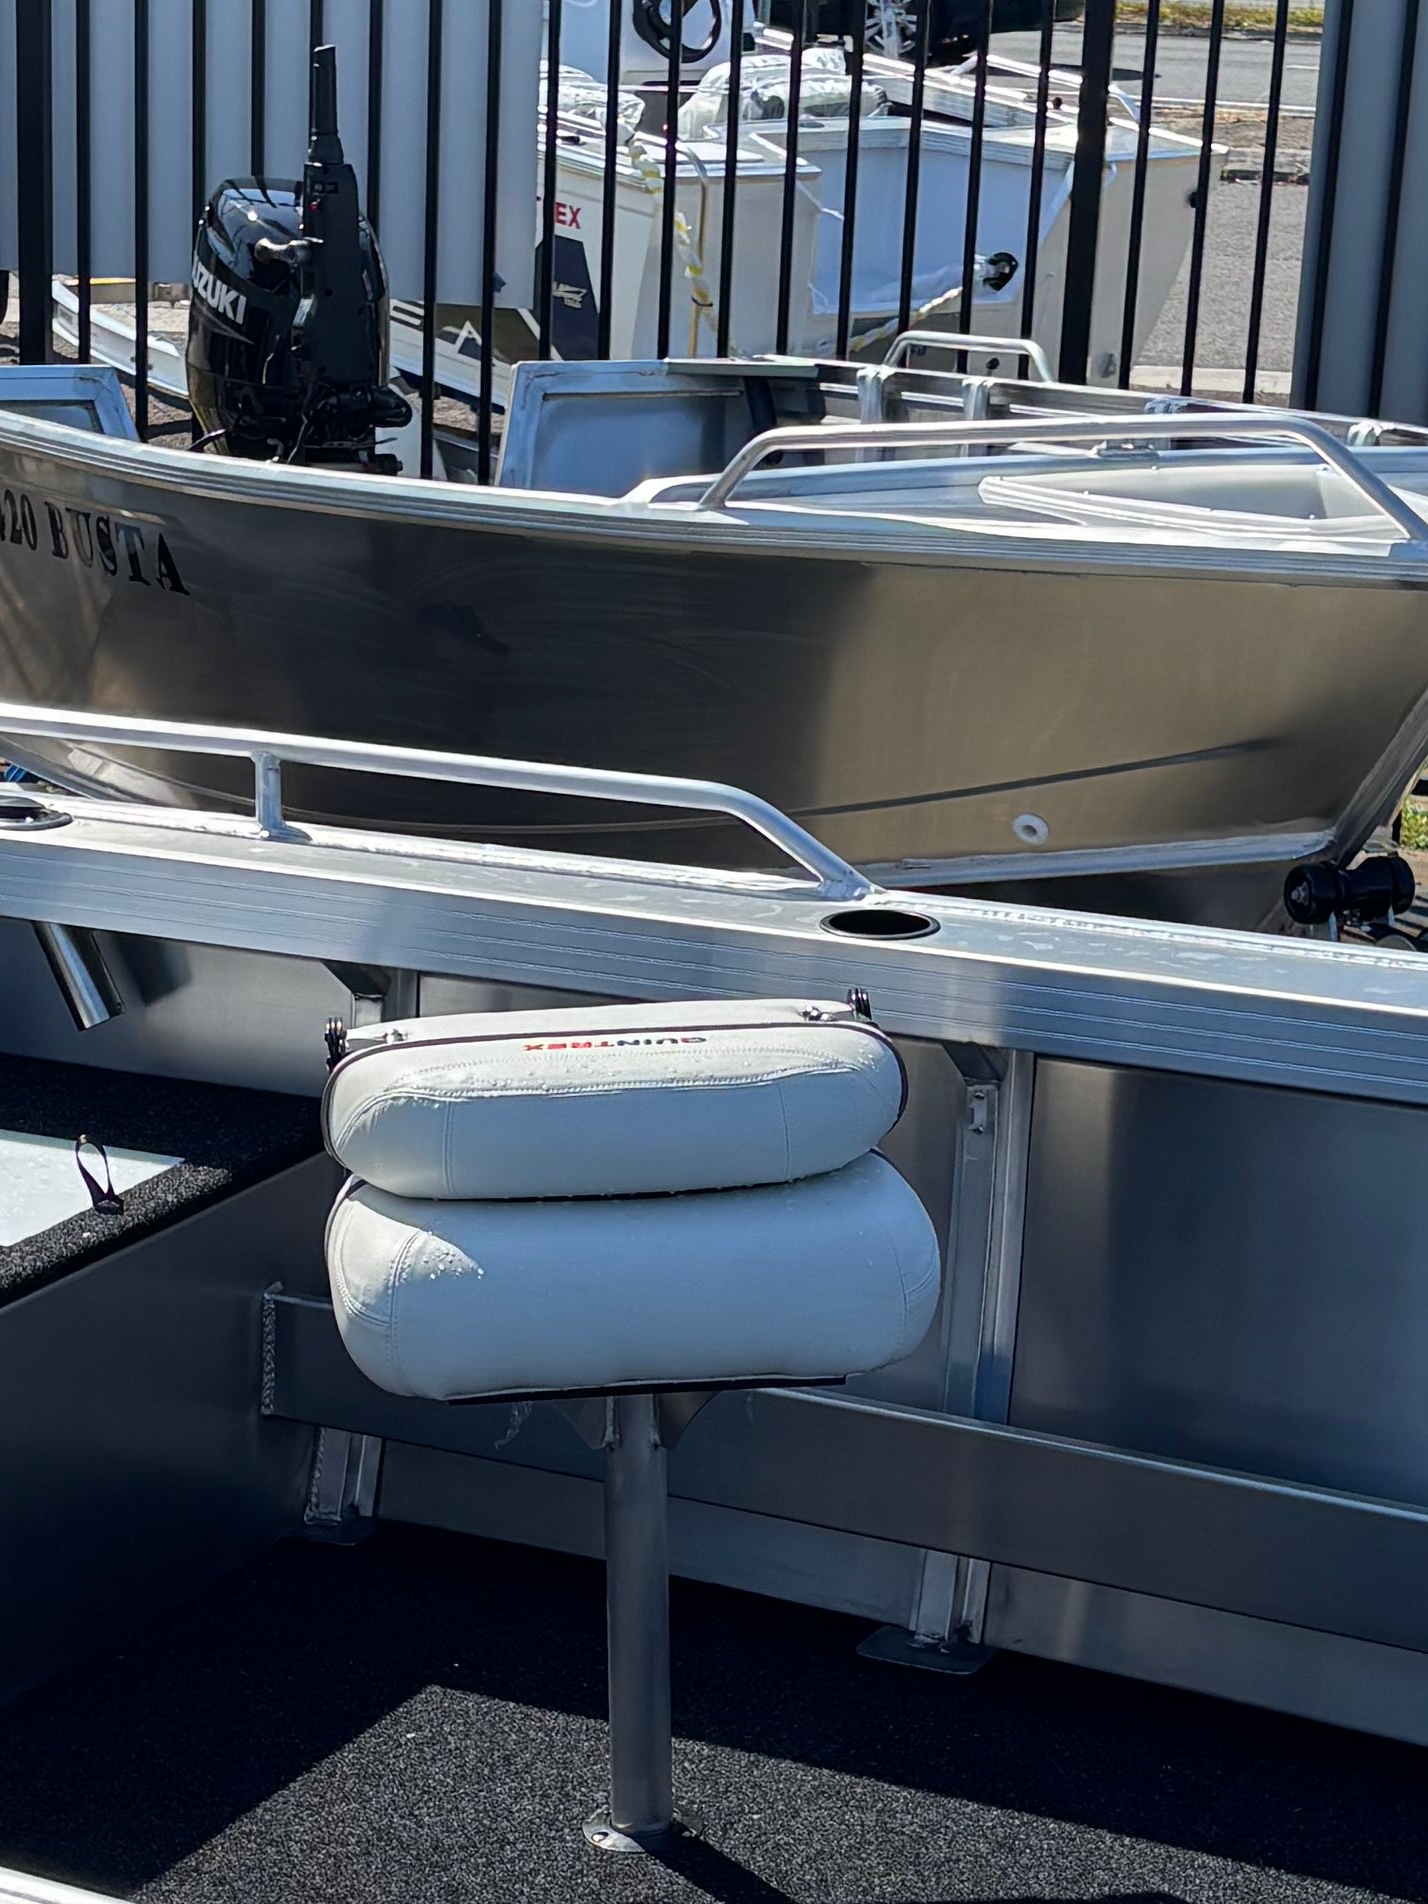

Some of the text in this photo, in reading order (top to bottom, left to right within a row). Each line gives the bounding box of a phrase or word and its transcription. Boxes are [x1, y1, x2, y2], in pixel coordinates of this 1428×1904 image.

[192, 248, 247, 325] UZUKI
[44, 500, 190, 596] BUSTA
[523, 1037, 707, 1052] QUINTREX
